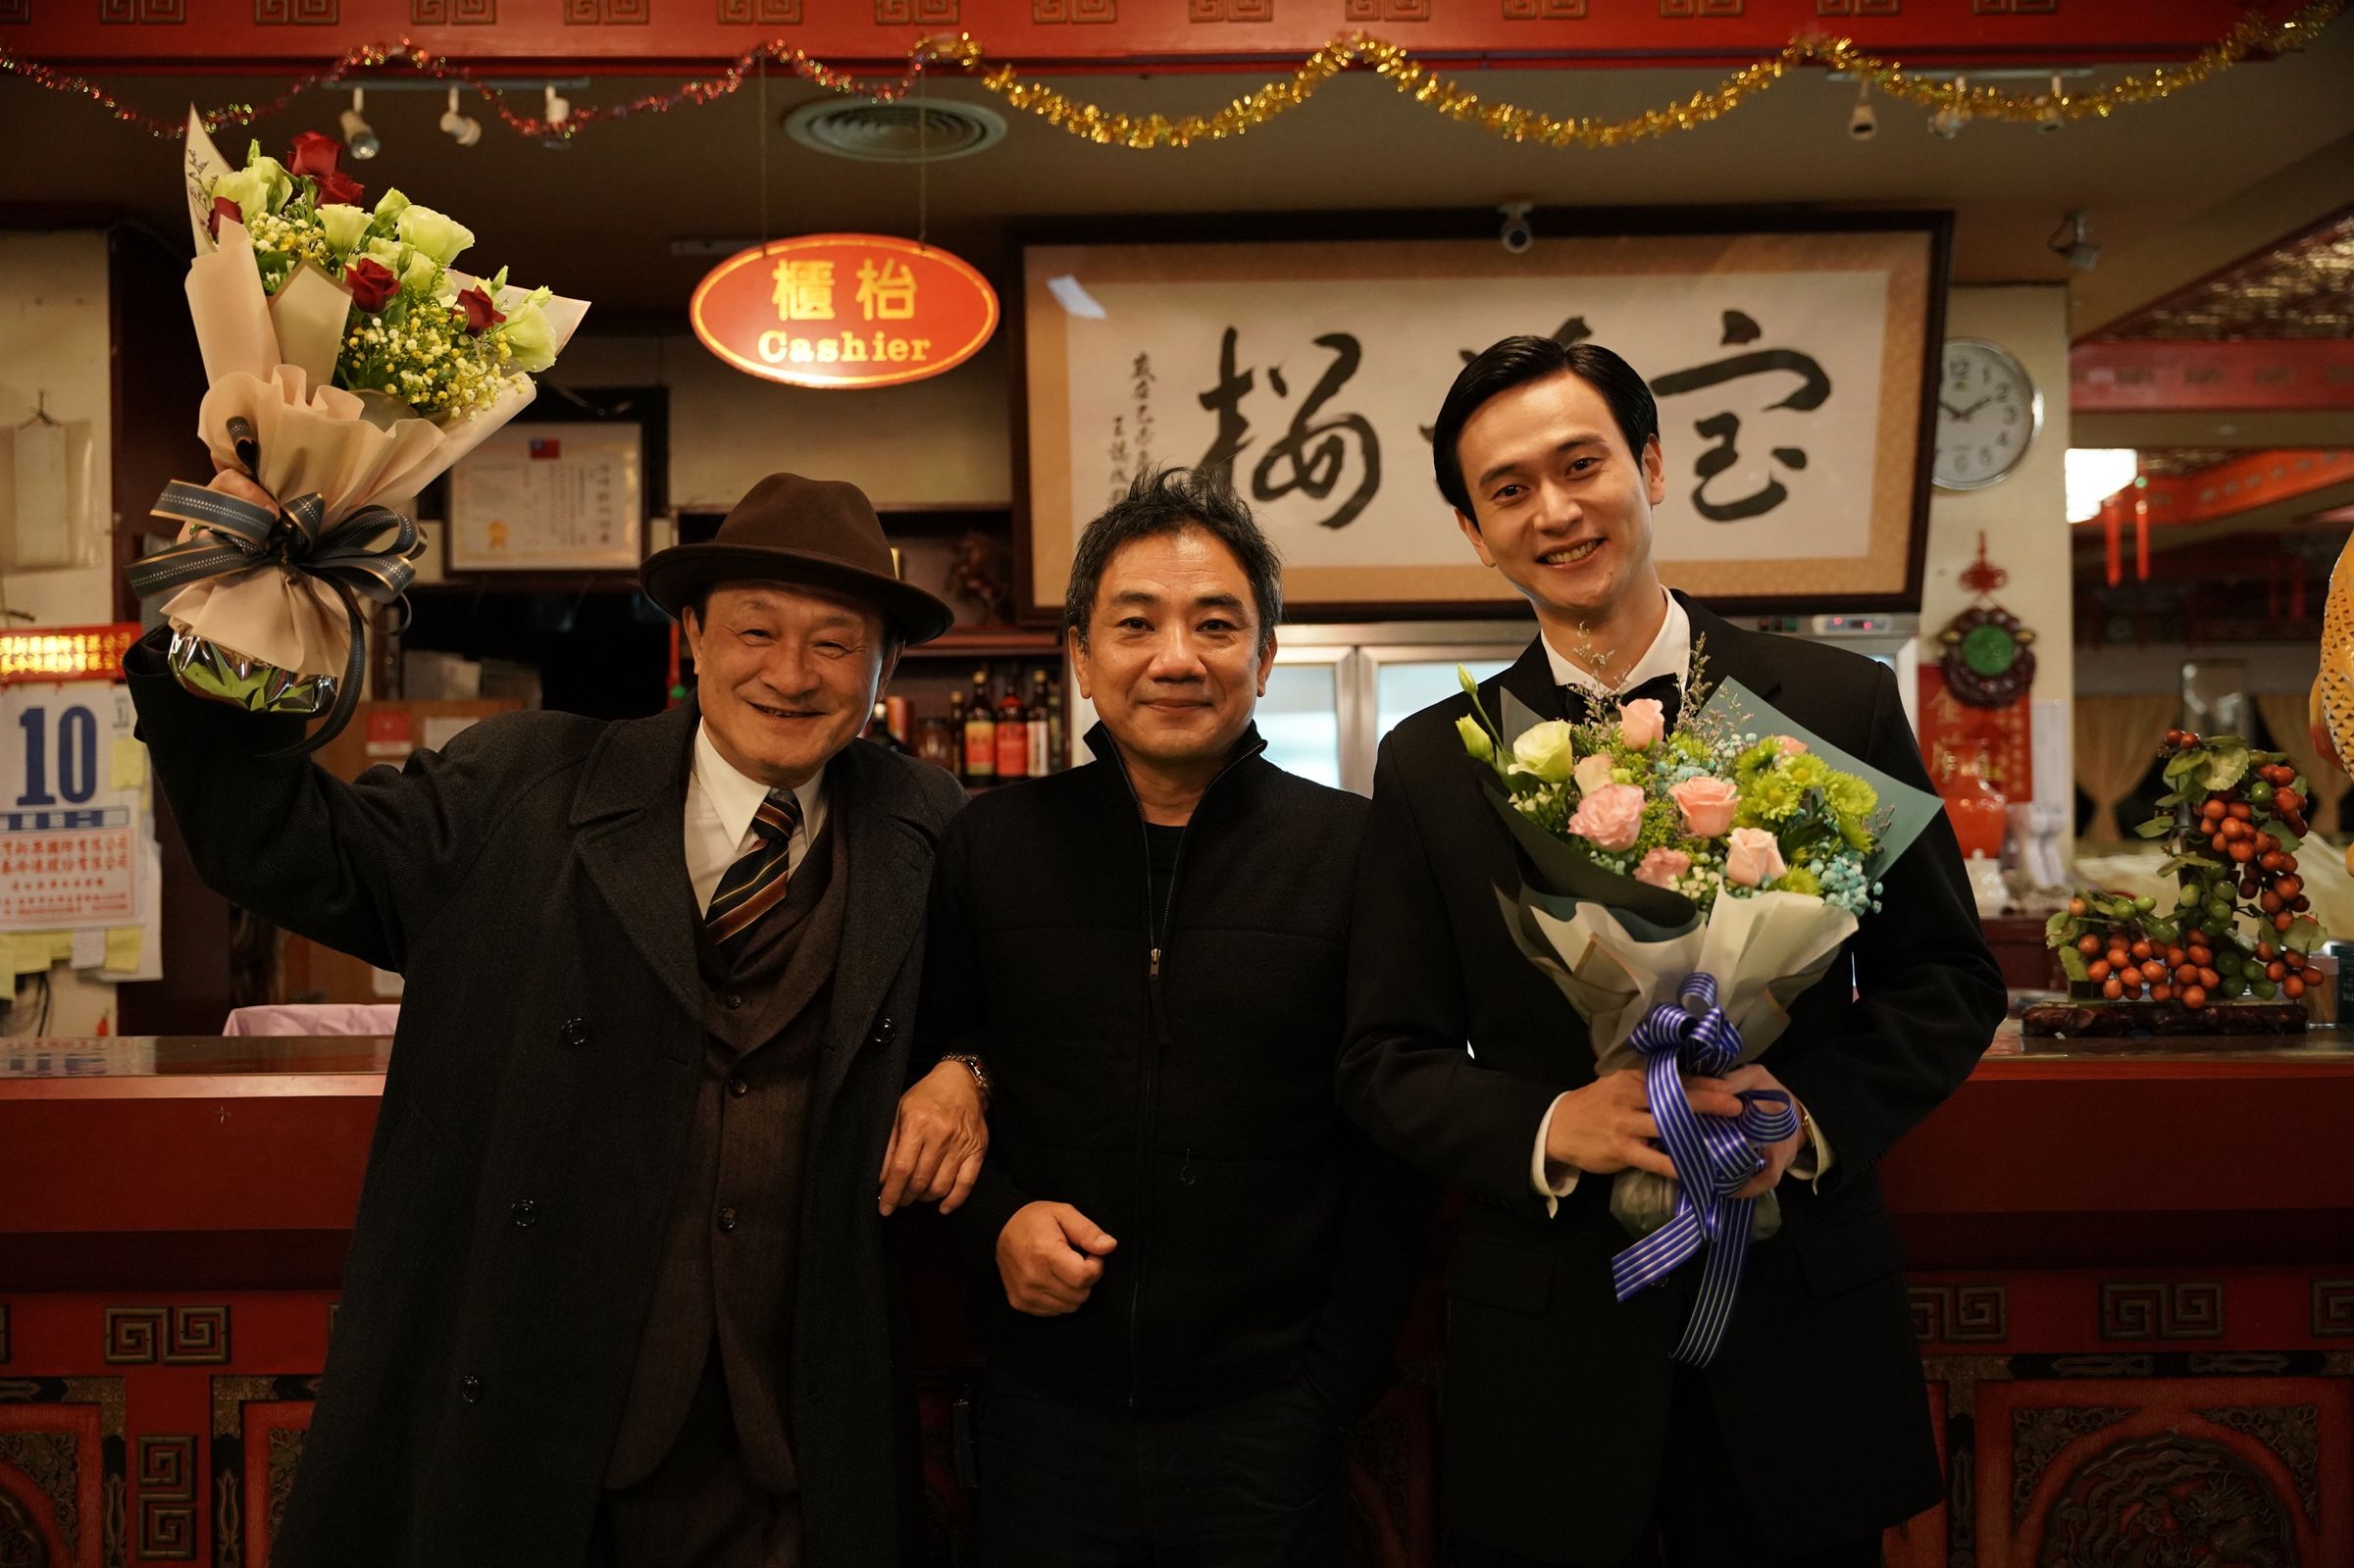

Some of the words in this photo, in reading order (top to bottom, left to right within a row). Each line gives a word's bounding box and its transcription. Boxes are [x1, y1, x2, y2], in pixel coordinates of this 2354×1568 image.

[757, 329, 931, 363] Cashier
[1995, 381, 2011, 403] 2
[2002, 404, 2019, 426] 3
[17, 705, 97, 806] 10
